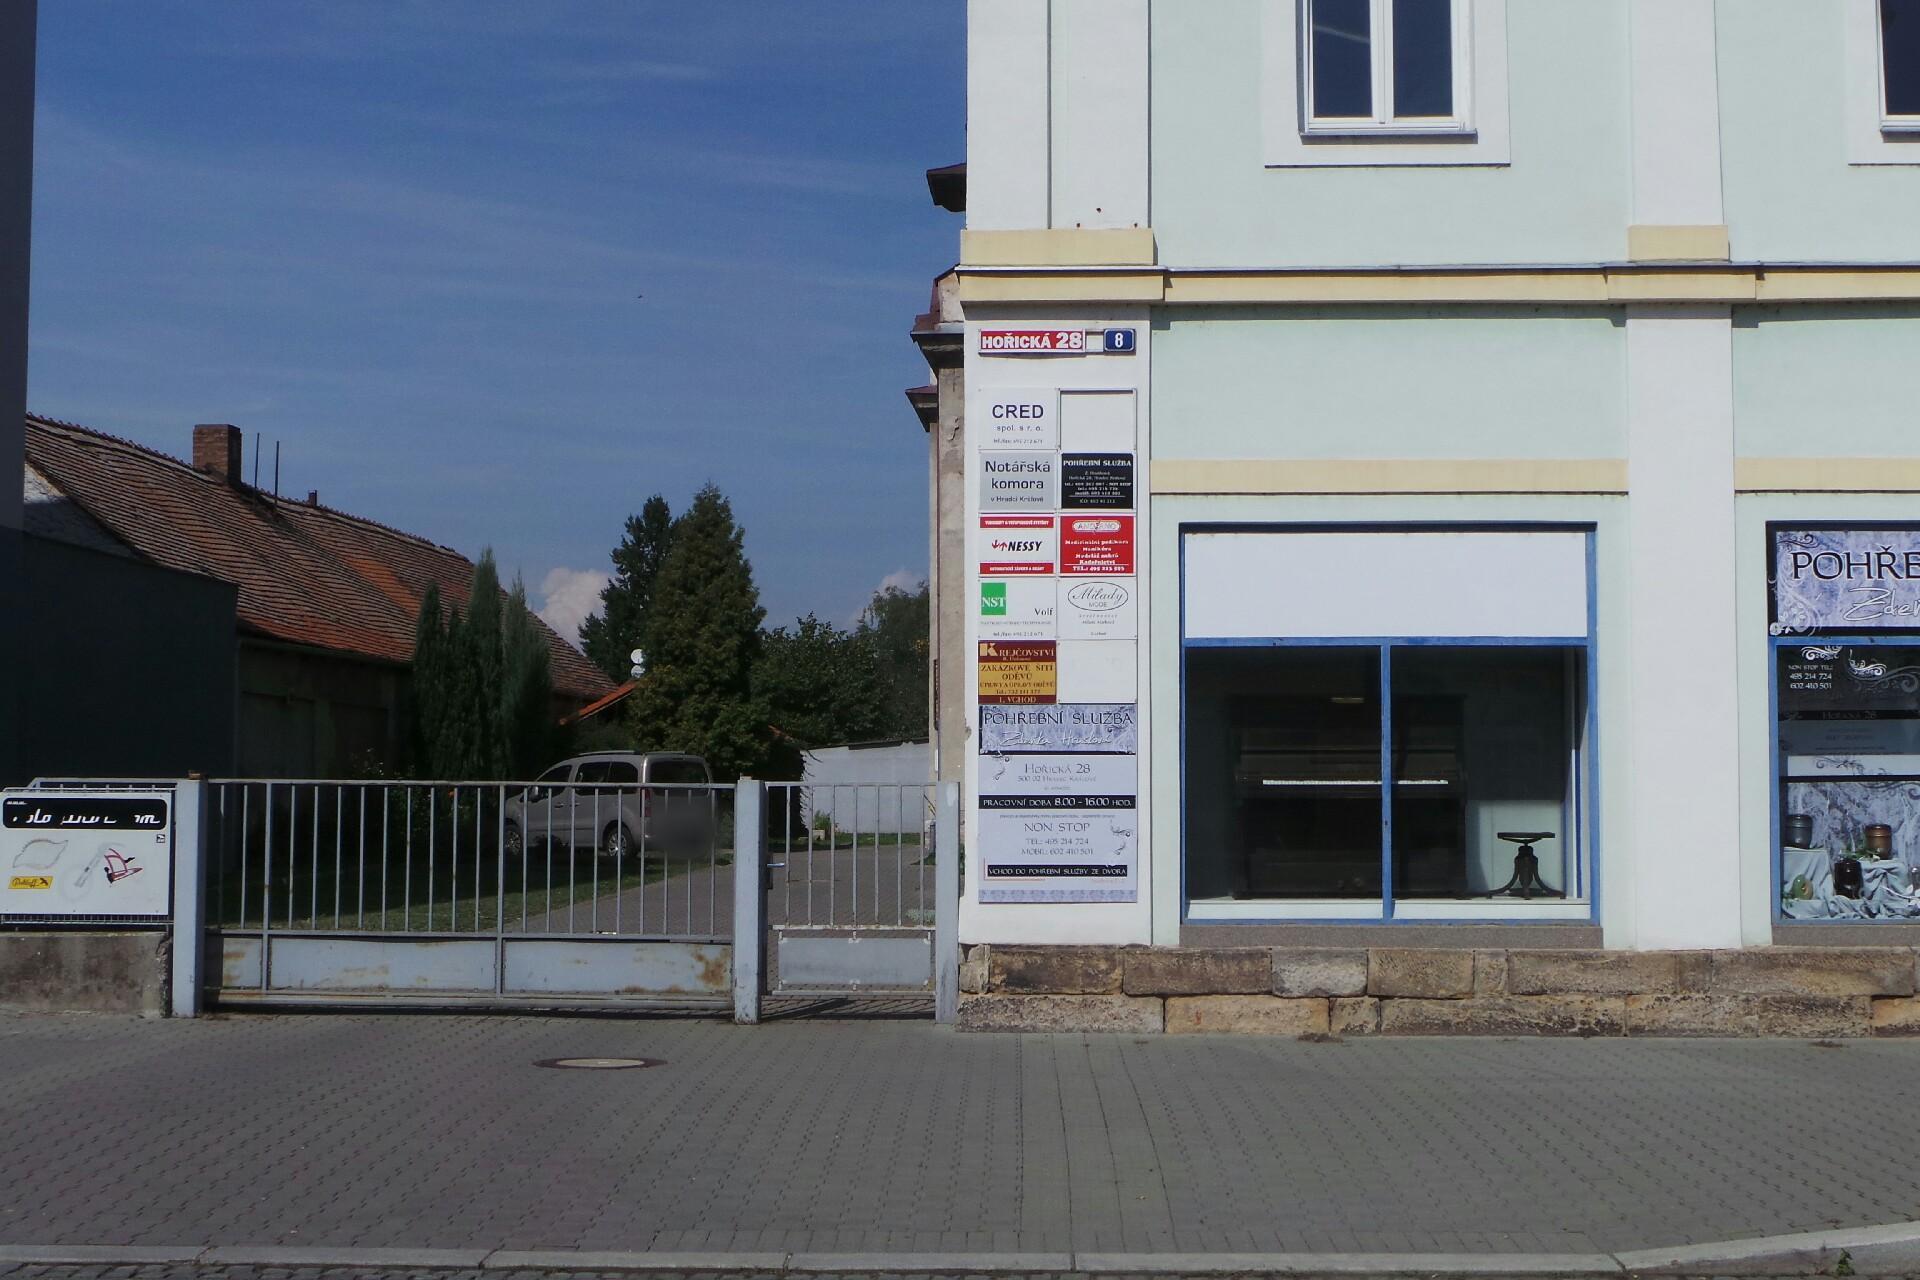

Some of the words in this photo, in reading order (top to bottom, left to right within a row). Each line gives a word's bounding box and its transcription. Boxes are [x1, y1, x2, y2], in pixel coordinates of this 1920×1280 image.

[982, 332, 1051, 348] HOŘICKÁ
[1056, 332, 1083, 349] 28
[1114, 332, 1124, 348] 8
[992, 404, 1044, 419] CRED
[985, 460, 1051, 473] Notářská
[991, 477, 1044, 489] komora
[1008, 541, 1042, 551] NESSY
[982, 597, 1004, 607] NST
[1034, 608, 1054, 616] Volf
[979, 643, 1055, 657] KREJČOVSTVÍ
[1804, 672, 1817, 680] 214
[1818, 672, 1832, 680] 724
[1789, 682, 1804, 690] 602
[1805, 682, 1818, 690] 410
[1819, 682, 1832, 690] 501
[984, 710, 1064, 725] POHŘEBNÍ
[1072, 710, 1134, 725] SLUŽBA
[1075, 763, 1091, 774] 28
[983, 798, 1026, 806] PRACOVNÍ
[1024, 822, 1053, 832] NON
[1058, 822, 1091, 832] STOP
[1028, 867, 1060, 875] POHŘEBNÍ
[1063, 867, 1088, 875] SLUŽBY
